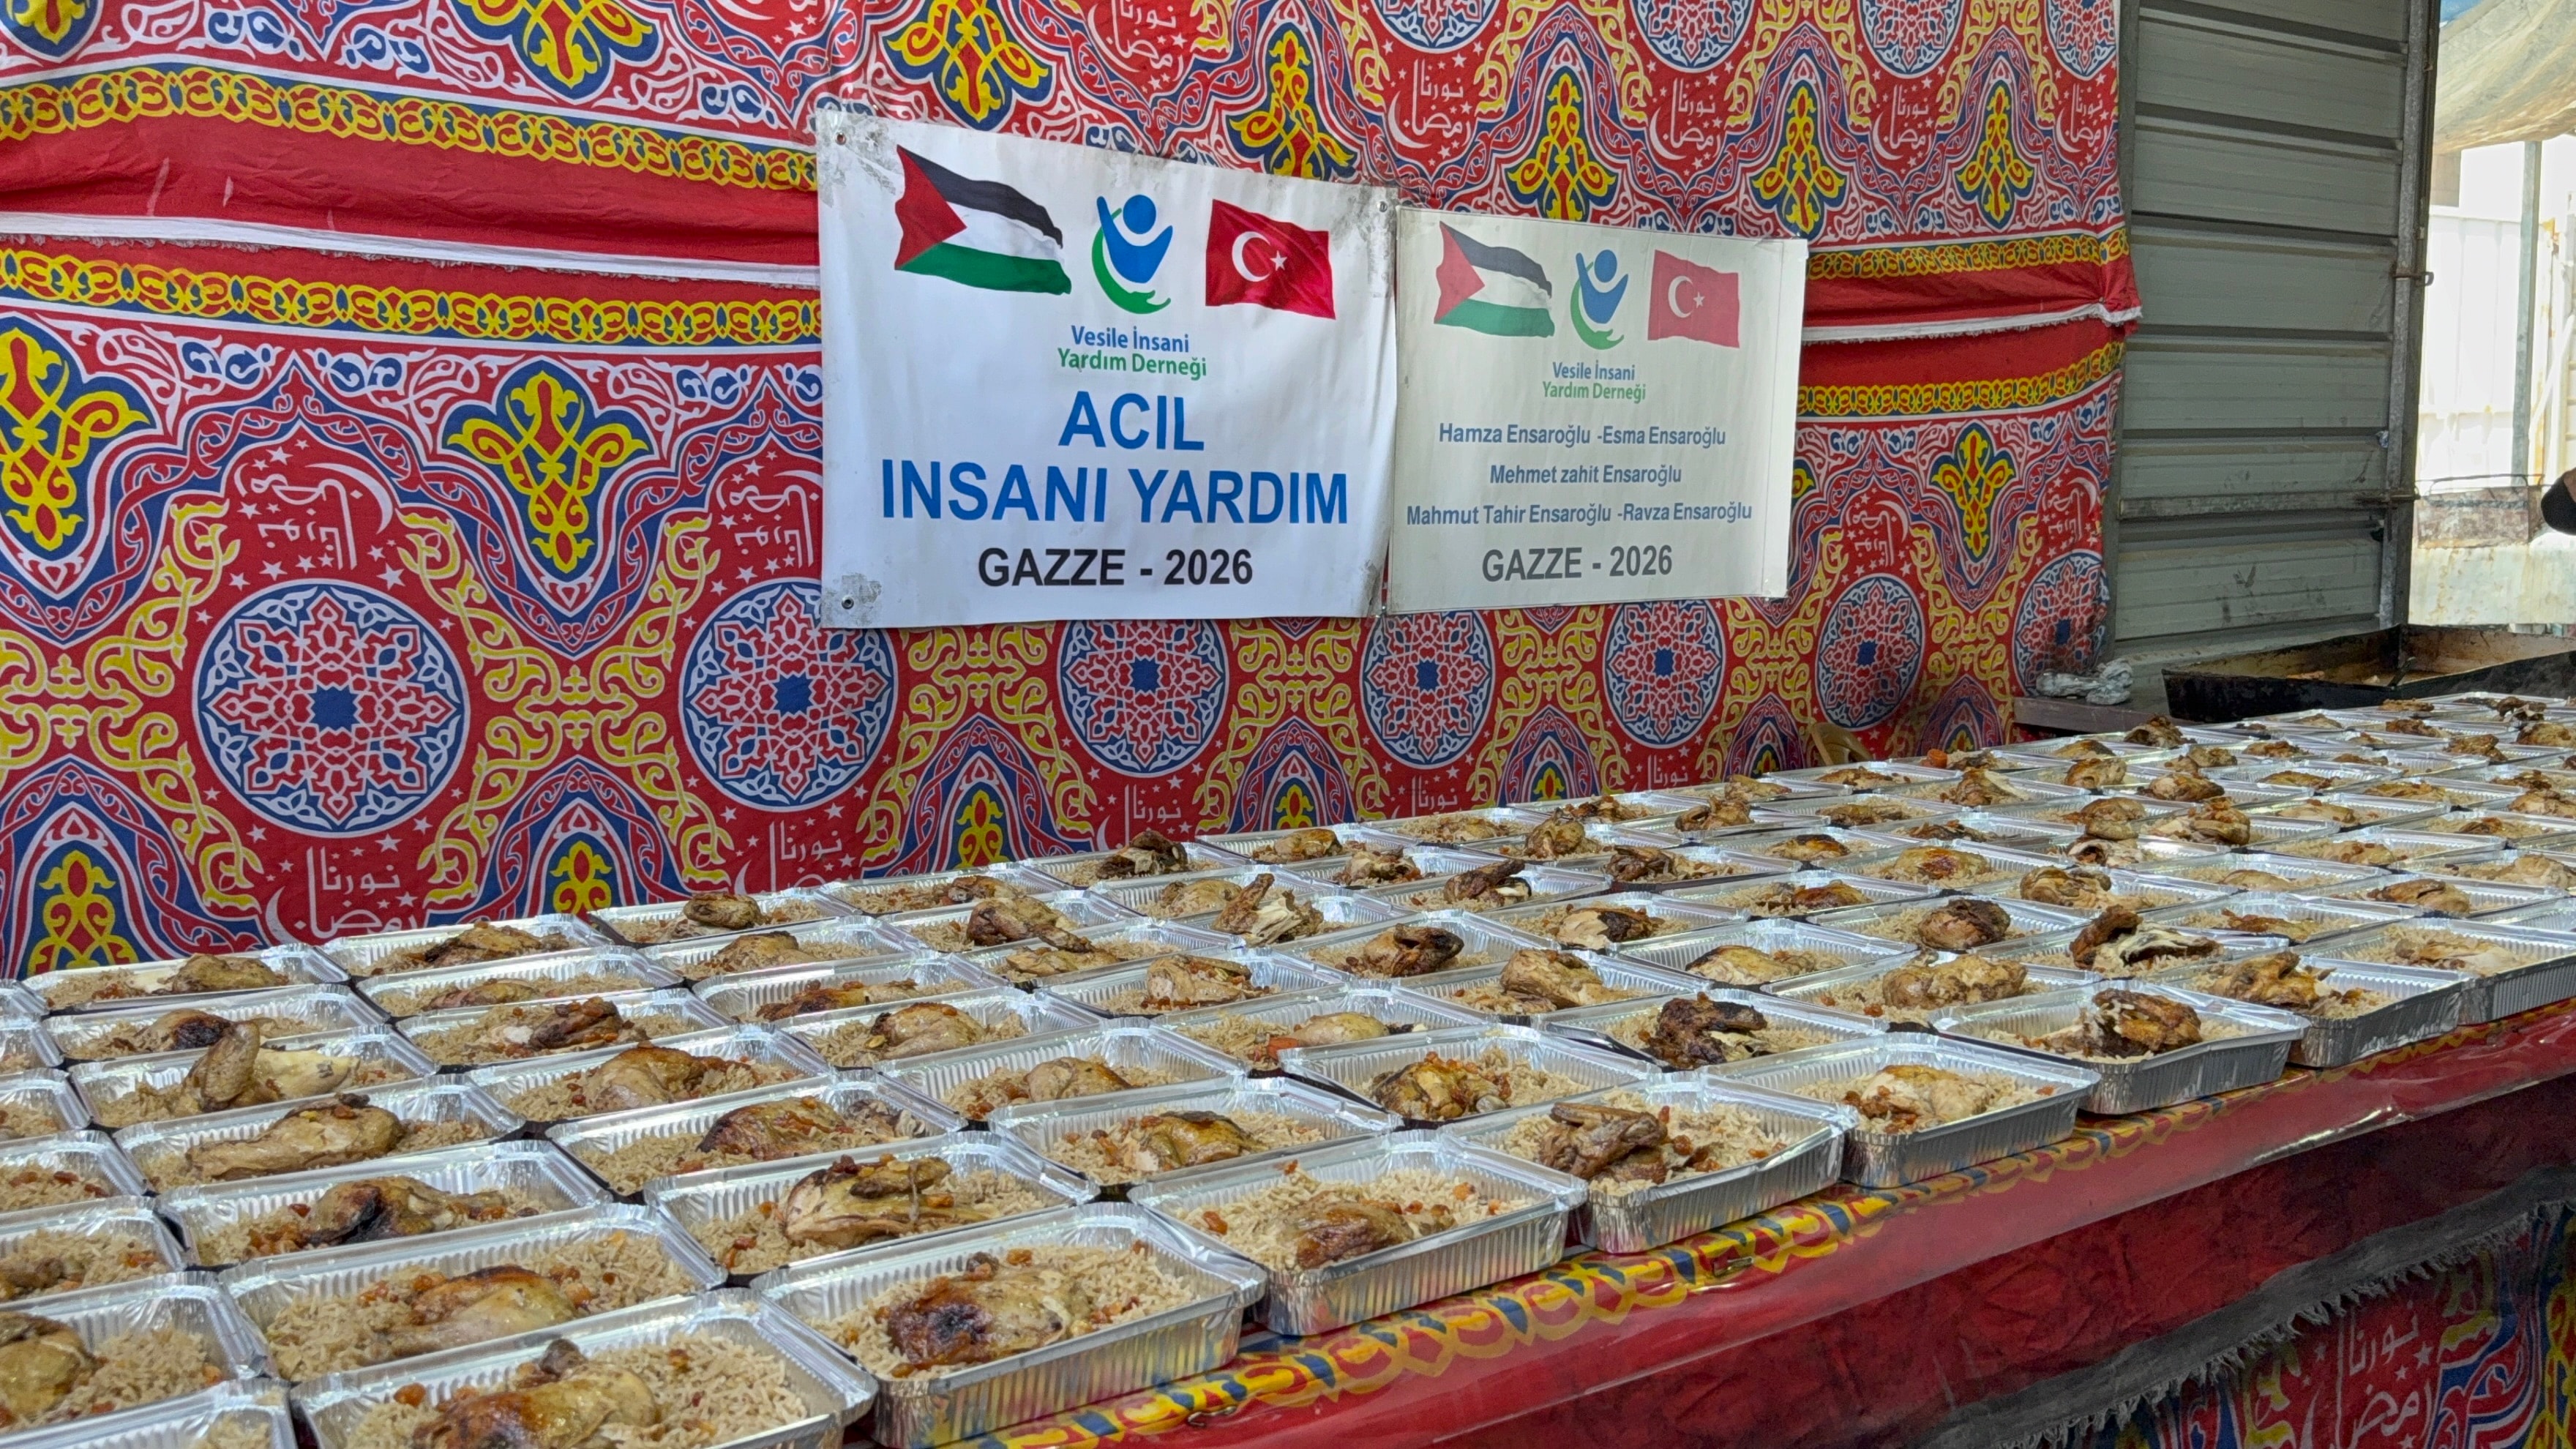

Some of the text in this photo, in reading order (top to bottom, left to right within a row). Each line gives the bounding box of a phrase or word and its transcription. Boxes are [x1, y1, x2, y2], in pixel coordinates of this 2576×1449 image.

[1071, 326, 1188, 353] Vesile İnsani
[1058, 348, 1206, 381] Yardım Derneği
[1553, 360, 1635, 381] Vesile İnsani
[1543, 381, 1645, 404] Yardım Derneği
[1058, 391, 1204, 451] ACIL
[1439, 423, 1725, 449] Hamza Ensaroğlu -Esma Ensaroğlu
[1491, 465, 1681, 487] Mehmet zahit Ensaroğlu
[883, 460, 1347, 523] INSANI YARDIM
[1407, 501, 1751, 526] Mahmut Tahir Ensaroğlu -Ravza Ensaroğlu
[978, 548, 1125, 586] GAZZE
[1164, 549, 1252, 585] 2026
[1483, 547, 1581, 582] GAZZE
[1609, 545, 1671, 576] 2026
